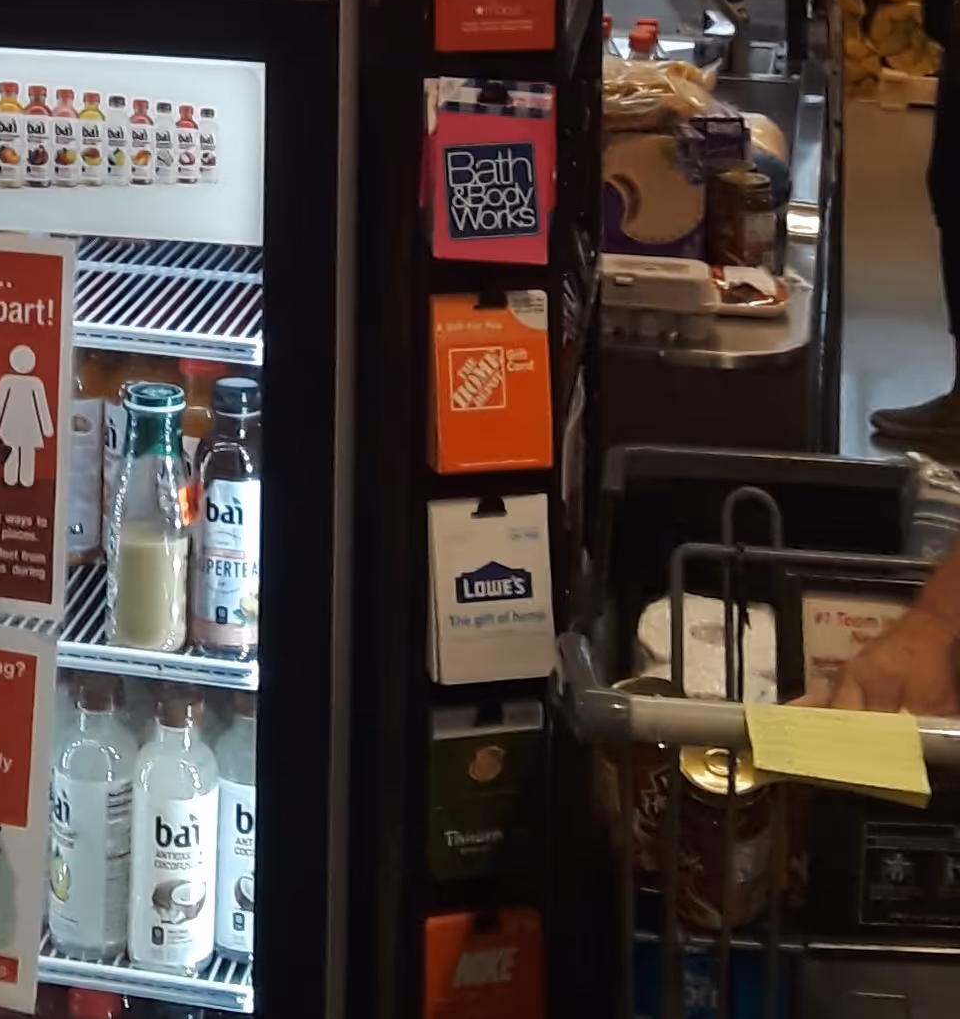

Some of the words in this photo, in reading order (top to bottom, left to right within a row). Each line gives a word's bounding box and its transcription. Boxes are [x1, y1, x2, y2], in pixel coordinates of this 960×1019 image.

[446, 148, 534, 187] Bath
[450, 205, 536, 232] Works
[207, 498, 243, 525] bai
[462, 575, 527, 599] LOWE'S
[155, 813, 200, 848] bai
